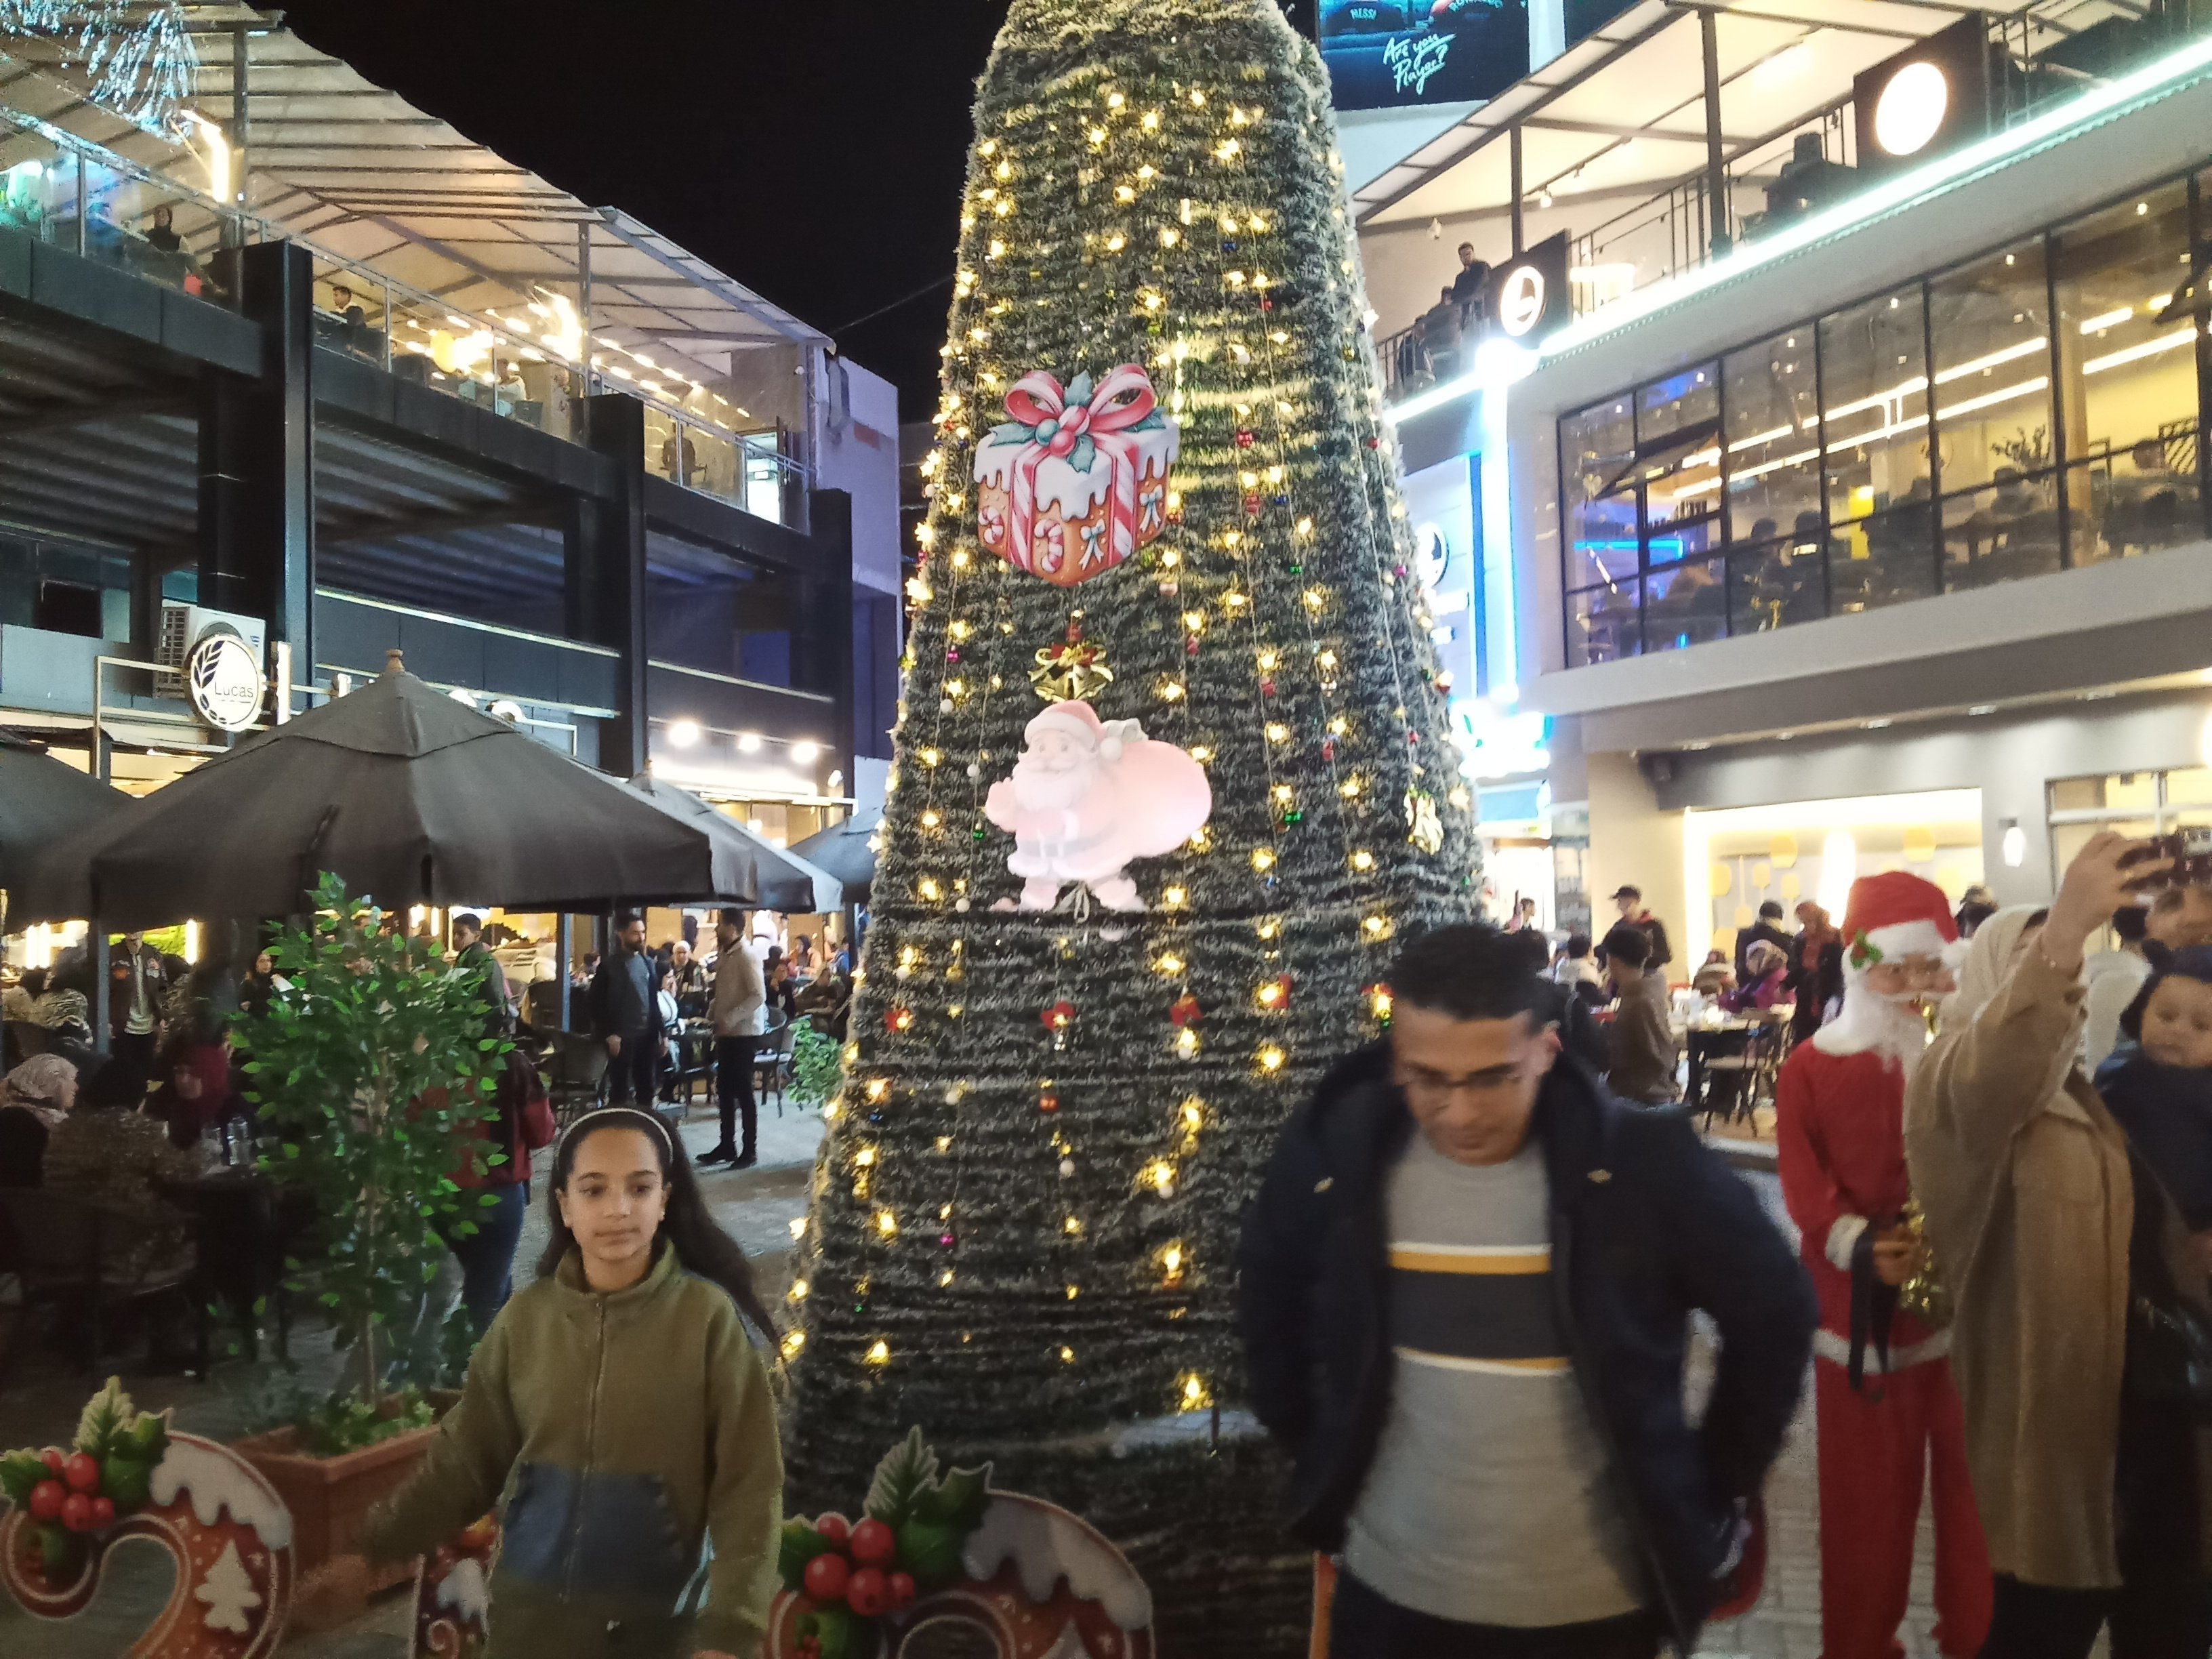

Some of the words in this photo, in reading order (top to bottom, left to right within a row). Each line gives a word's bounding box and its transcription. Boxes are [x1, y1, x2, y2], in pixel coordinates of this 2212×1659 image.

[1382, 37, 1411, 65] Are
[1412, 33, 1456, 70] you
[214, 681, 254, 698] Lucas
